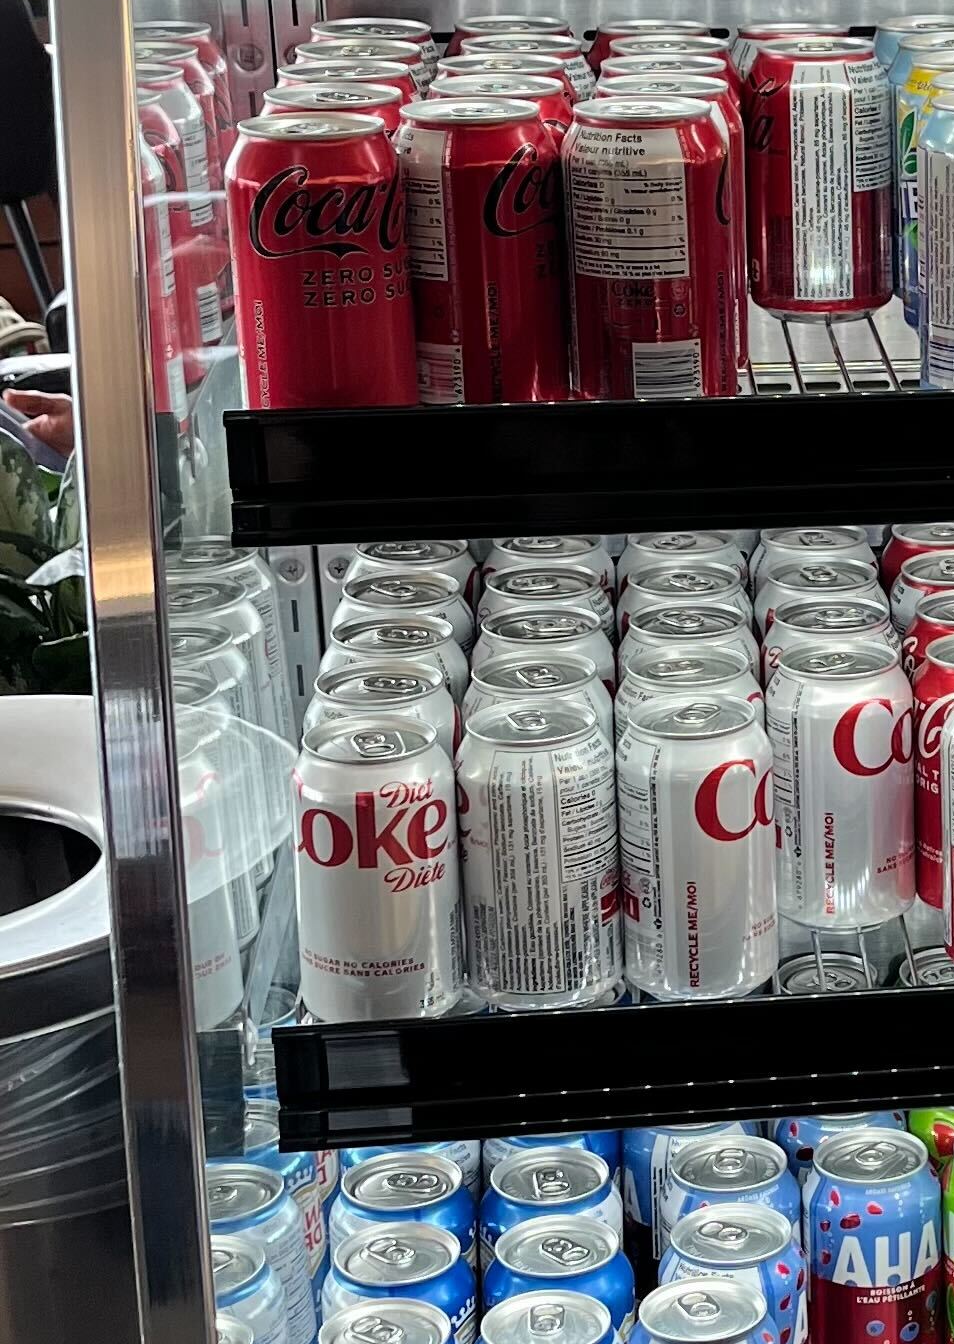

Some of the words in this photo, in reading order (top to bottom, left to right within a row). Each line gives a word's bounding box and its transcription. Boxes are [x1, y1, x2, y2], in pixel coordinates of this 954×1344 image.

[601, 146, 646, 156] nutritive
[615, 133, 643, 143] Facts
[303, 267, 373, 286] ZERO
[304, 288, 376, 307] ZERO
[832, 697, 914, 778] Co
[379, 778, 433, 808] Diet
[694, 758, 774, 842] Co
[297, 791, 450, 869] oke
[823, 812, 834, 860] ME/MOI
[384, 862, 446, 893] Diète
[823, 862, 835, 915] RECYCLE
[686, 881, 698, 932] ME/MOI
[362, 957, 414, 969] CALORIES
[374, 962, 425, 976] CALORIES
[687, 933, 699, 988] RECYCLE
[832, 1220, 940, 1289] AHA
[856, 1295, 880, 1304] L'EAU
[870, 1287, 908, 1297] BOISSON
